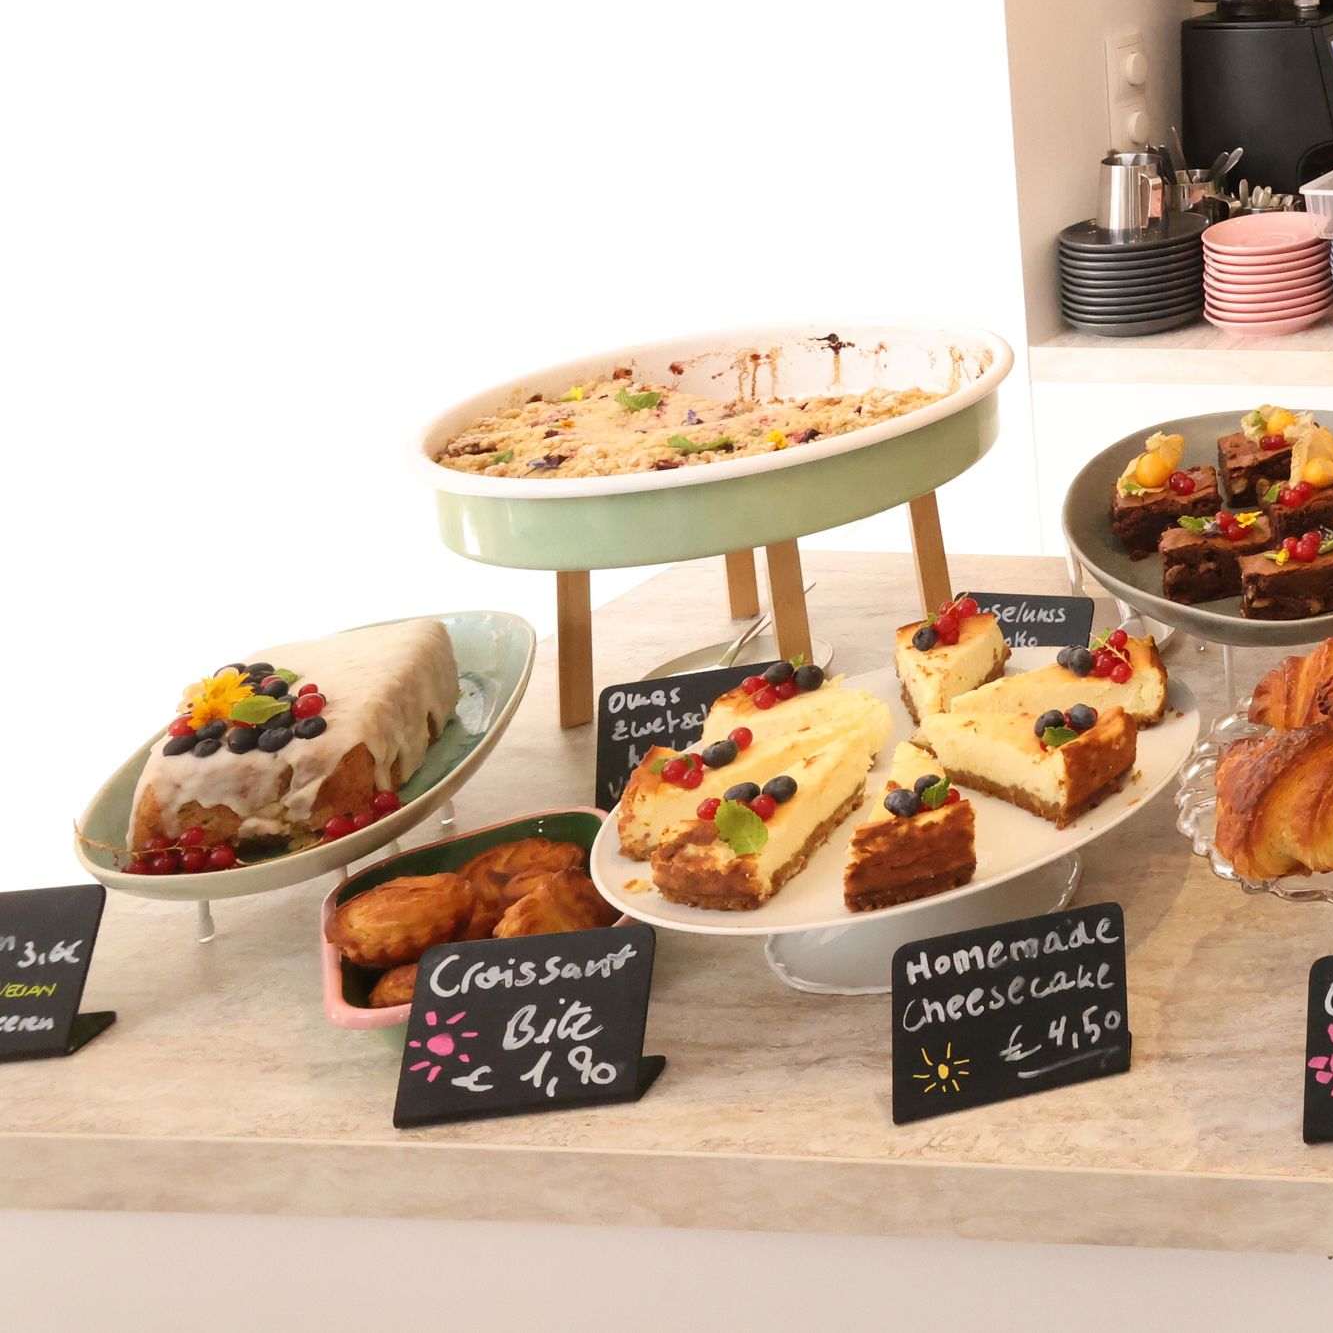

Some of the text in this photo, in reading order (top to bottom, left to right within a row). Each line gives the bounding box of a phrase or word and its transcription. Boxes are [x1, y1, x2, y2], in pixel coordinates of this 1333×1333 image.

[430, 944, 637, 997] Croissant
[907, 917, 1119, 985] Homemade
[1048, 1005, 1120, 1049] 4,50
[451, 1046, 617, 1097] € 1,90
